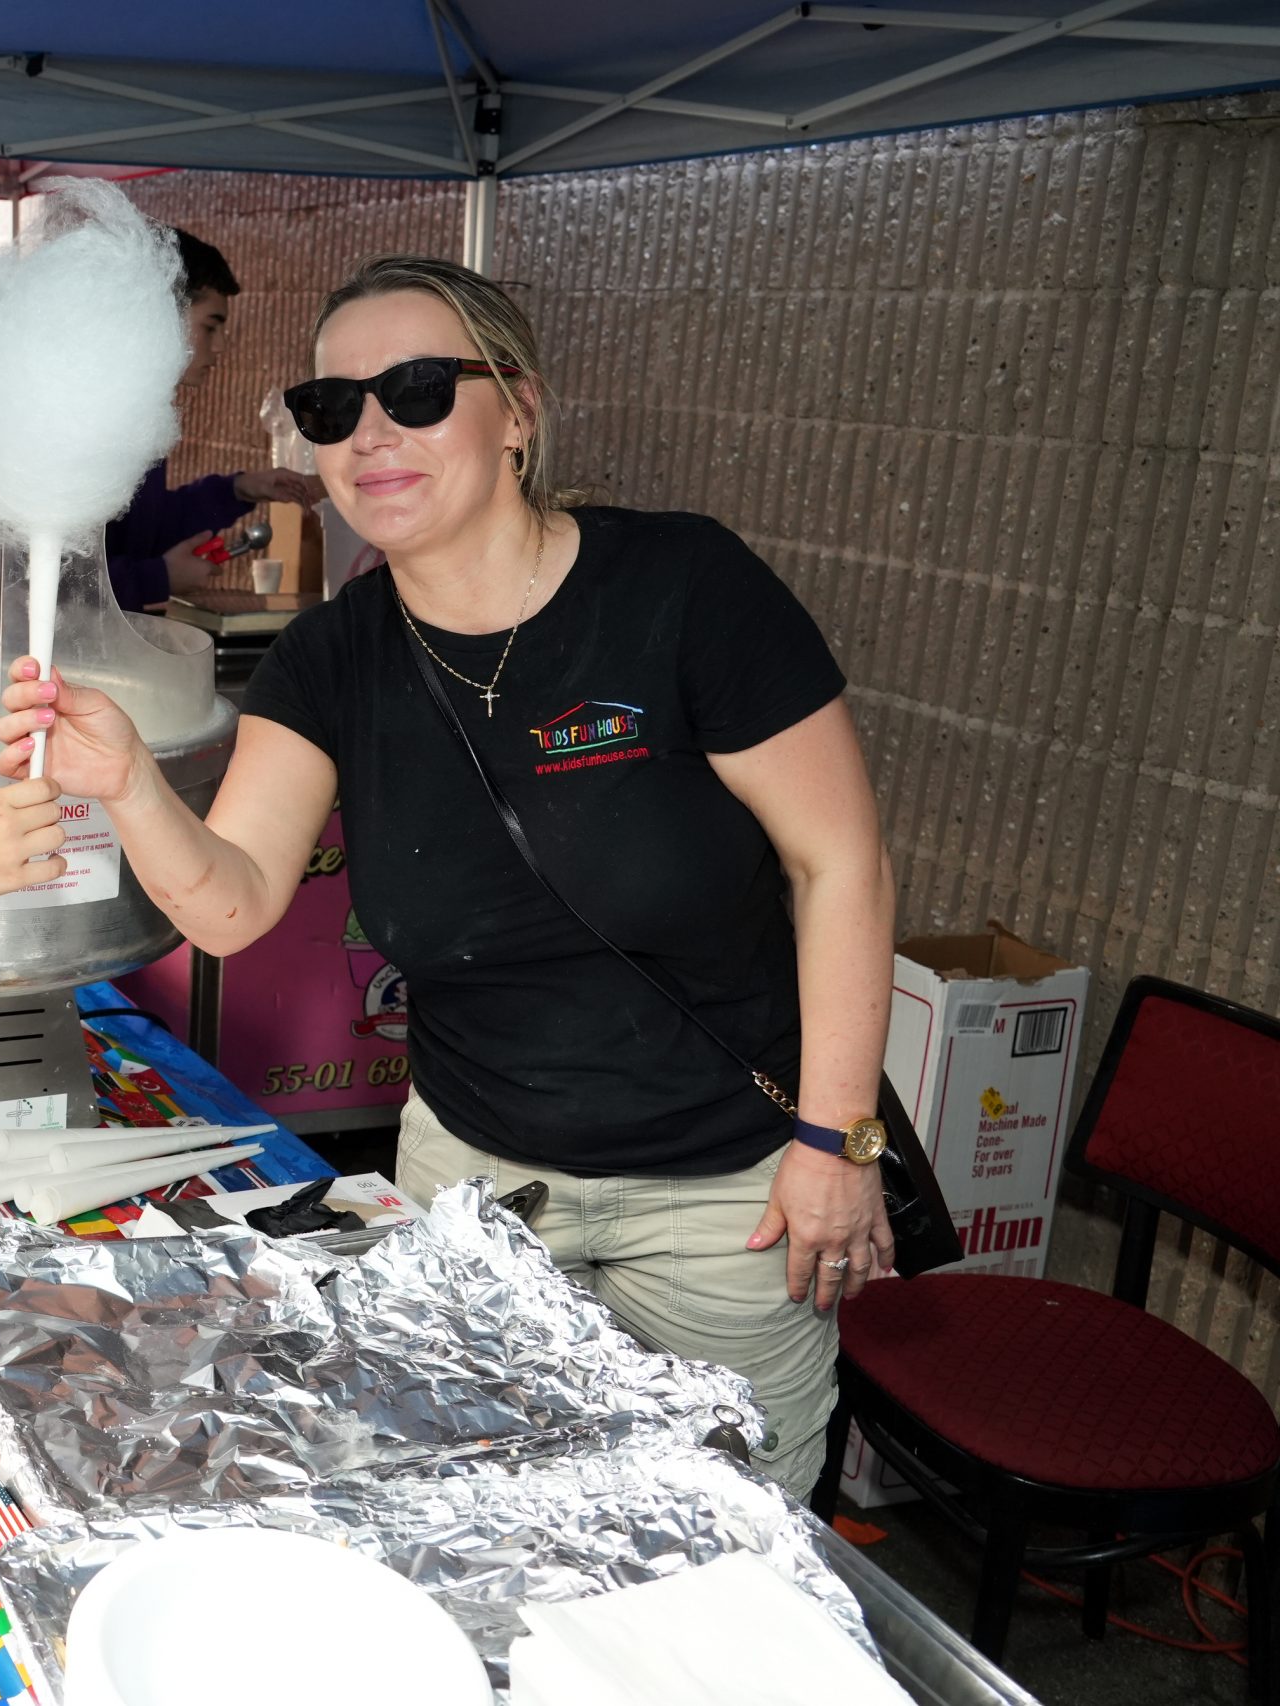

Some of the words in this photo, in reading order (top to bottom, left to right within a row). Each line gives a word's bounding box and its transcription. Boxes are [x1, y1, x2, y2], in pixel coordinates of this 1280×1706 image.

[543, 728, 569, 748] KIDS
[570, 723, 597, 744] FUN
[597, 714, 636, 738] HOUSE
[535, 747, 649, 775] www.kidsfunhouse.com
[60, 803, 90, 819] ING!
[82, 832, 99, 841] SPINNER
[27, 884, 46, 892] COLLECT
[47, 882, 64, 890] COTTON
[262, 1059, 354, 1095] 55-01
[368, 1056, 412, 1085] 69
[978, 1118, 1018, 1133] Machine
[1022, 1114, 1047, 1128] Made
[976, 1134, 1004, 1148] Cone-
[974, 1150, 989, 1163] For
[993, 1149, 1014, 1161] over
[972, 1165, 984, 1178] 50
[986, 1163, 1012, 1179] years
